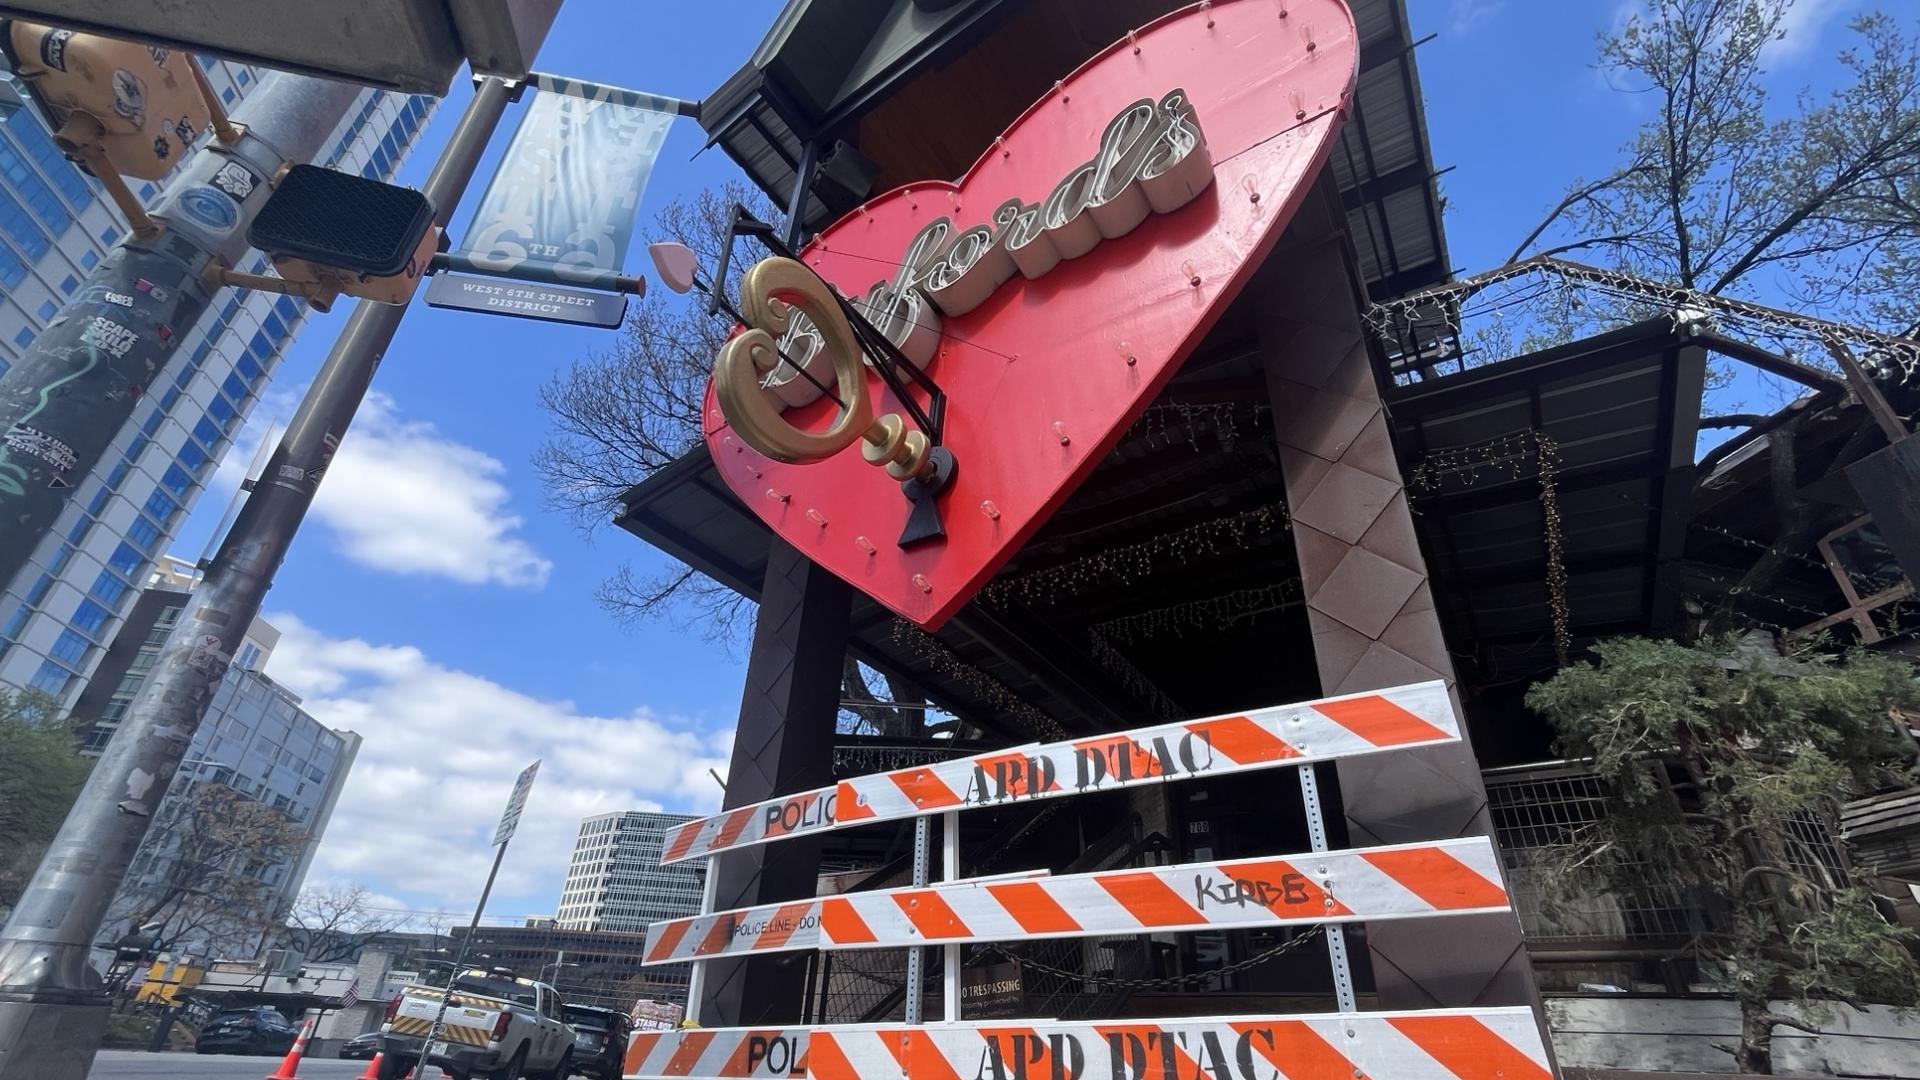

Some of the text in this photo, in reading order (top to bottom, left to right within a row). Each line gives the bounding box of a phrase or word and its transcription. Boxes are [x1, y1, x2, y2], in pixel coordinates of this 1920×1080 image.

[463, 283, 595, 307] WEST 6TH STREET
[487, 297, 561, 313] DISTRICT
[964, 729, 1213, 805] APD DTAC
[765, 794, 838, 835] POLIC
[735, 921, 768, 936] POLICE
[769, 919, 791, 933] LINE
[800, 915, 815, 929] DO
[969, 979, 1020, 997] TRESPASSING
[634, 1019, 657, 1028] STASH
[658, 1022, 673, 1030] BOX
[748, 1036, 806, 1075] POL
[976, 1028, 1280, 1080] APD DTAC
